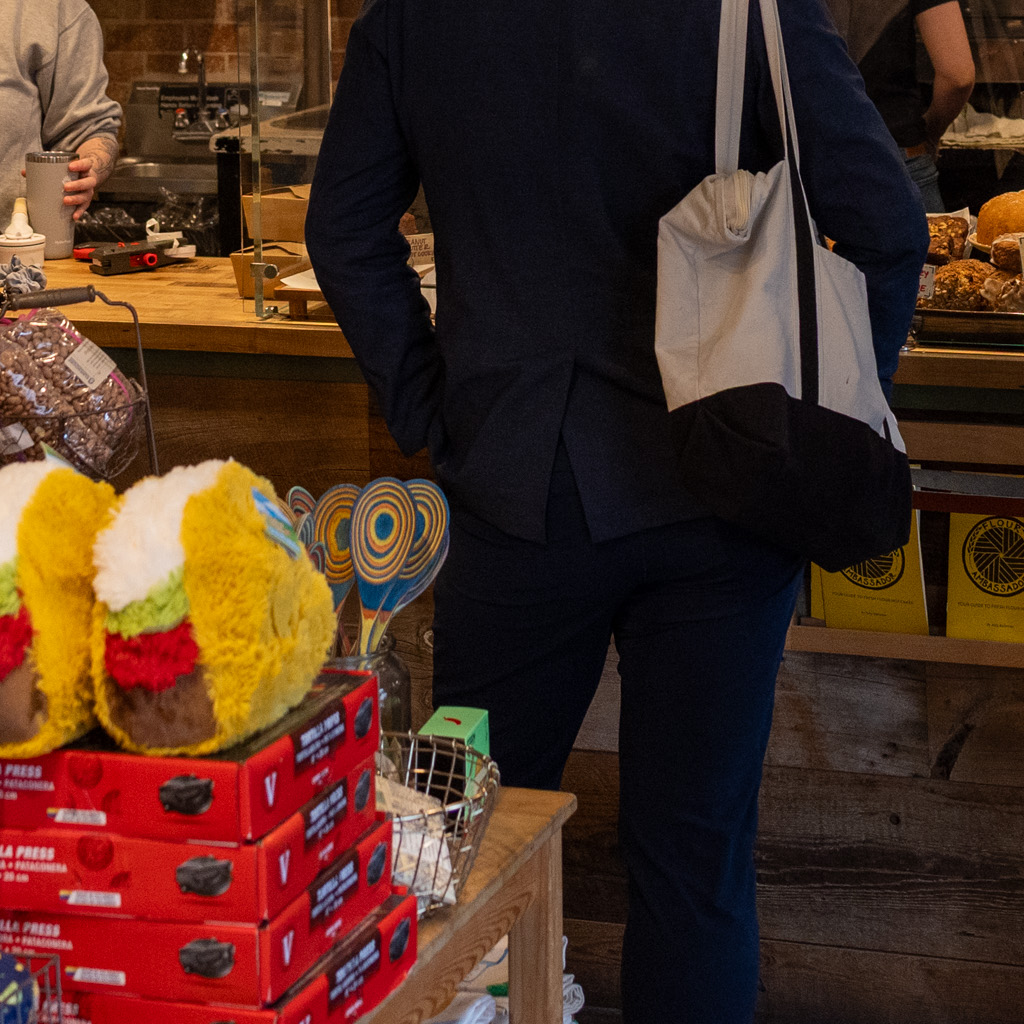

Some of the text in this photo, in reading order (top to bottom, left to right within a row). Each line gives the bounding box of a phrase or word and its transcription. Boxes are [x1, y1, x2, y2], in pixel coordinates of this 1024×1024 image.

[5, 765, 42, 779] PRESS
[16, 845, 55, 861] PRESS
[23, 922, 60, 937] PRESS
